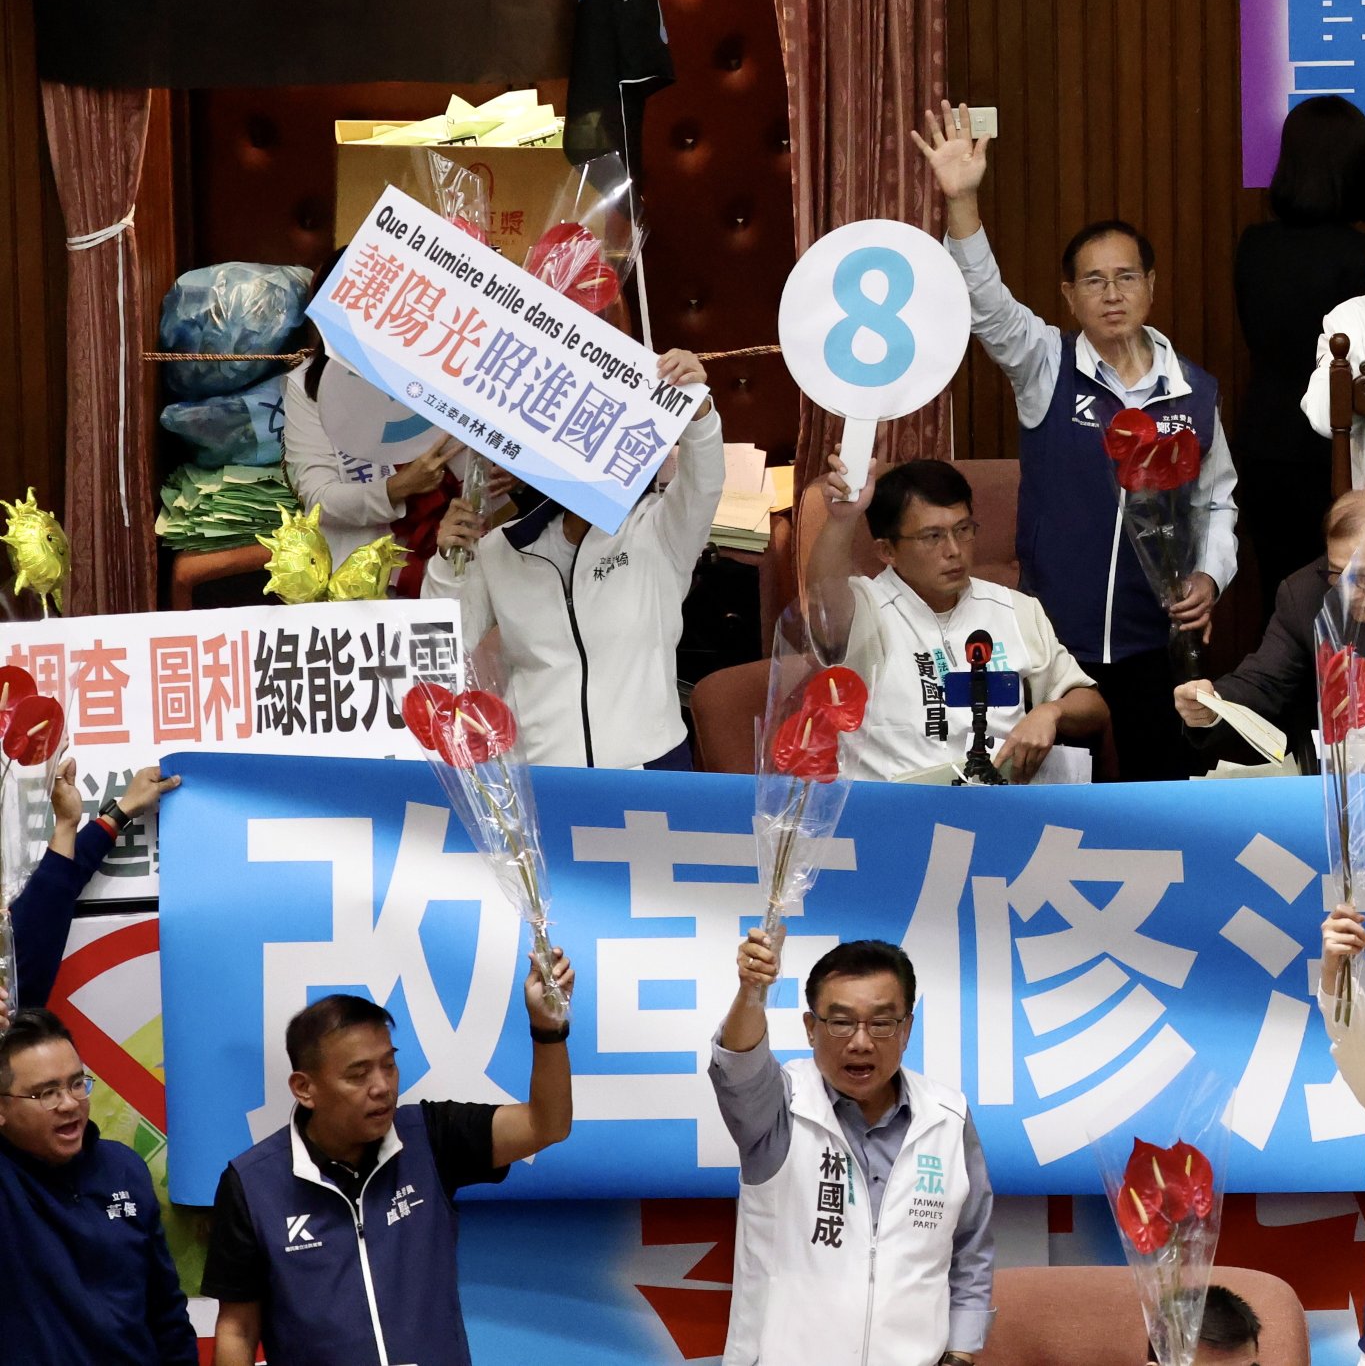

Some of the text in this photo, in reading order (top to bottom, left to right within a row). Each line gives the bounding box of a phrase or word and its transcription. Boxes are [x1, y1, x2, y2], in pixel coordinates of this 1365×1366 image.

[376, 205, 408, 240] Que
[407, 225, 426, 252] la
[424, 236, 484, 289] lumière
[482, 273, 525, 315] brille
[523, 302, 564, 339] dans
[561, 324, 581, 350] le
[823, 246, 916, 388] 8
[330, 242, 668, 488] 讓陽光照進國會
[1156, 422, 1197, 434] 鄭天
[149, 622, 458, 745] 圖利綠能光電
[811, 1147, 847, 1249] 林國成
[909, 1208, 943, 1220] PEOPLE'S
[912, 1220, 938, 1230] PARTY
[913, 1197, 945, 1208] TAIWAN
